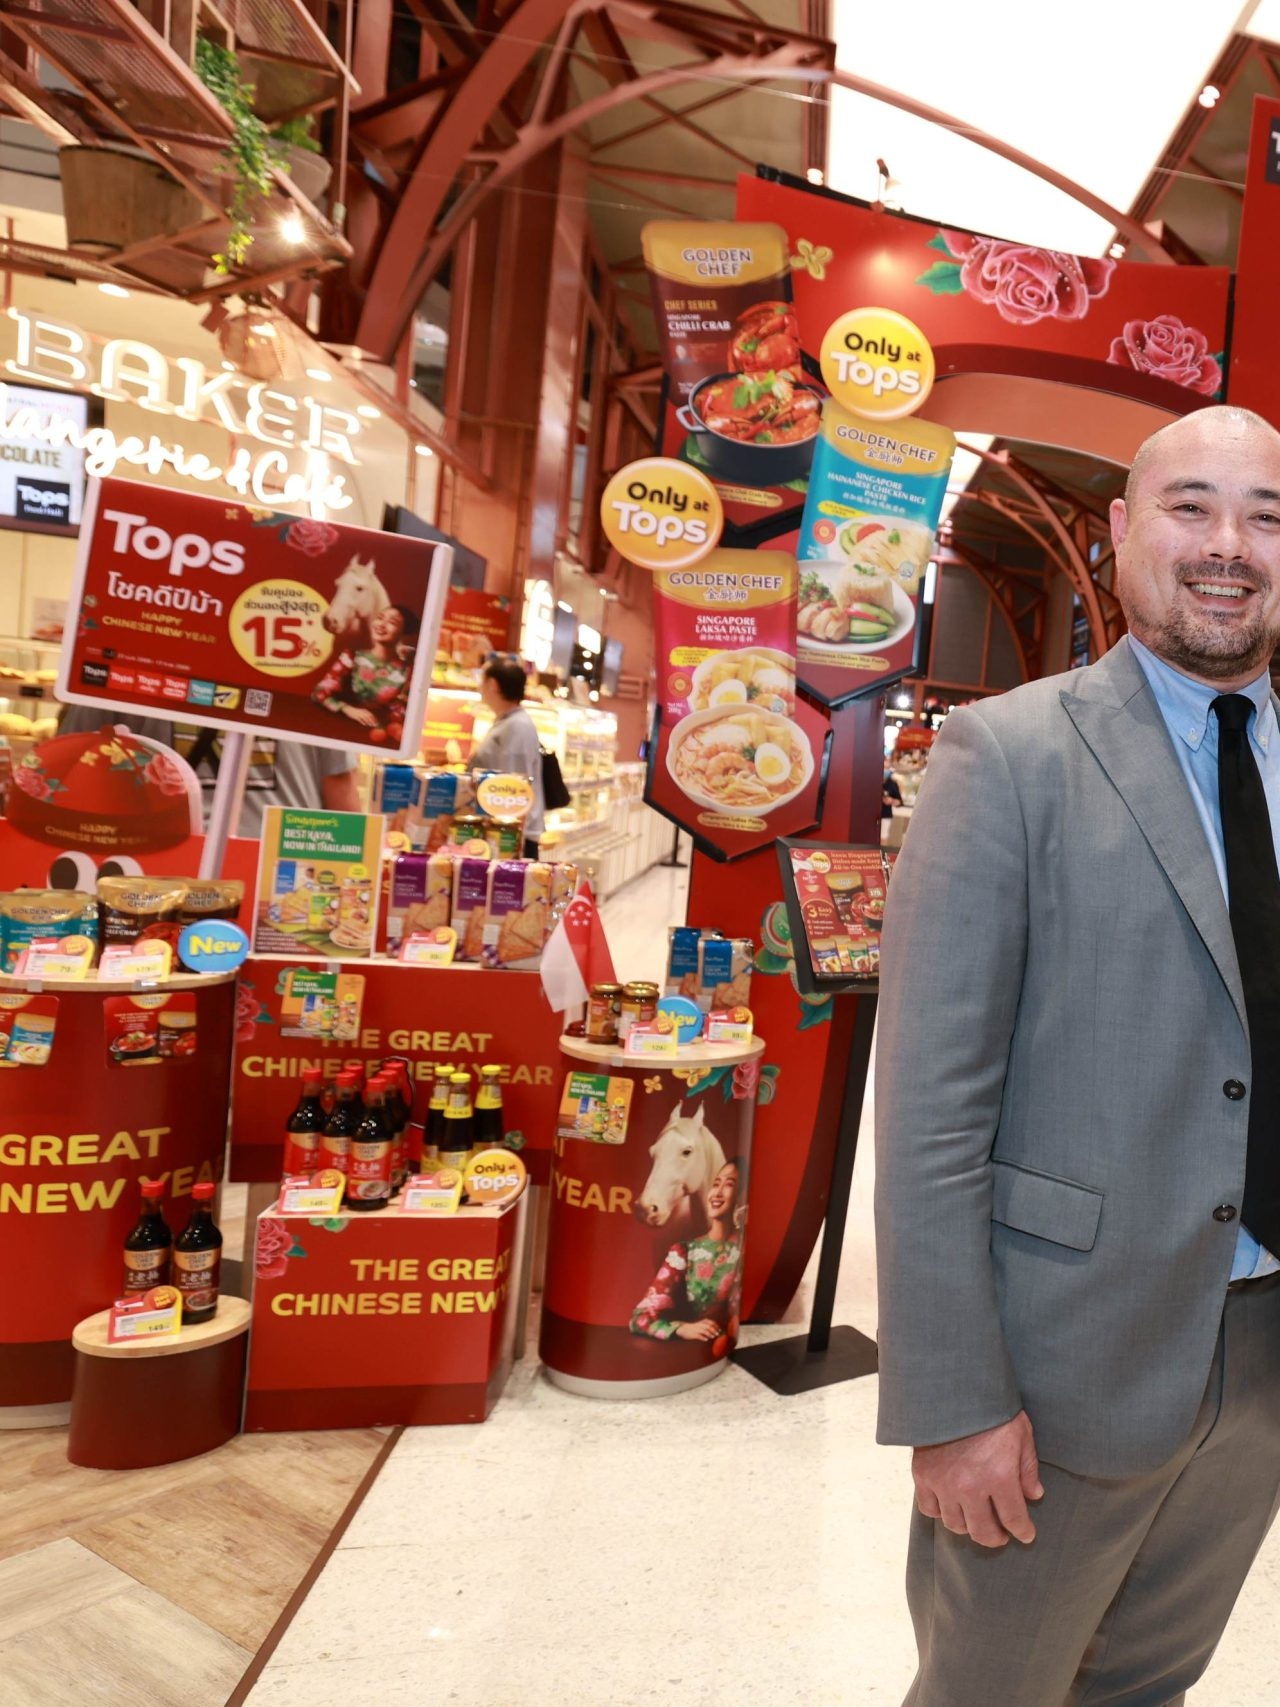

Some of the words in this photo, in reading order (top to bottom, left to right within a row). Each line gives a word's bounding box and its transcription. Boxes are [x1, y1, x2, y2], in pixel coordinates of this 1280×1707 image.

[682, 247, 752, 263] GOLDEN
[696, 262, 740, 276] CHEF
[668, 320, 701, 331] CHILLI
[701, 320, 732, 331] CRAB
[844, 332, 901, 363] Only
[906, 349, 922, 363] at
[5, 306, 362, 465] BAKER
[829, 351, 923, 397] Tops
[836, 425, 897, 451] GOLDEN
[899, 443, 937, 463] CHEF
[226, 448, 251, 495] &
[855, 472, 904, 490] SINGAPORE
[17, 484, 70, 508] Tops
[626, 481, 688, 512] Only
[693, 500, 710, 512] at
[827, 472, 872, 490] HAINANESE
[872, 483, 909, 502] CHICKEN
[909, 494, 927, 506] RICE
[611, 501, 708, 546] Tops
[103, 509, 245, 576] Tops
[669, 572, 737, 587] GOLDEN
[740, 575, 783, 590] CHEF
[107, 571, 223, 617] โชคดีปีม้า
[141, 610, 182, 625] HAPPY
[696, 615, 756, 627] SINGAPORE
[102, 615, 154, 634] CHINESE
[155, 624, 184, 639] NEW
[184, 630, 216, 644] YEAR
[695, 625, 727, 635] LAKSA
[728, 626, 757, 636] PASTE
[481, 793, 529, 809] Tops
[488, 784, 517, 795] Only
[284, 828, 306, 839] BEST
[283, 840, 306, 851] NOW
[806, 904, 818, 918] 3
[189, 935, 243, 956] New
[657, 1009, 697, 1028] New
[388, 1029, 493, 1053] GREAT
[0, 1127, 171, 1166] GREAT
[474, 1163, 506, 1175] Only
[466, 1174, 521, 1192] Tops
[555, 1171, 633, 1215] YEAR
[0, 1178, 127, 1214] NEW
[350, 1258, 419, 1281] THE
[271, 1291, 422, 1316] CHINESE
